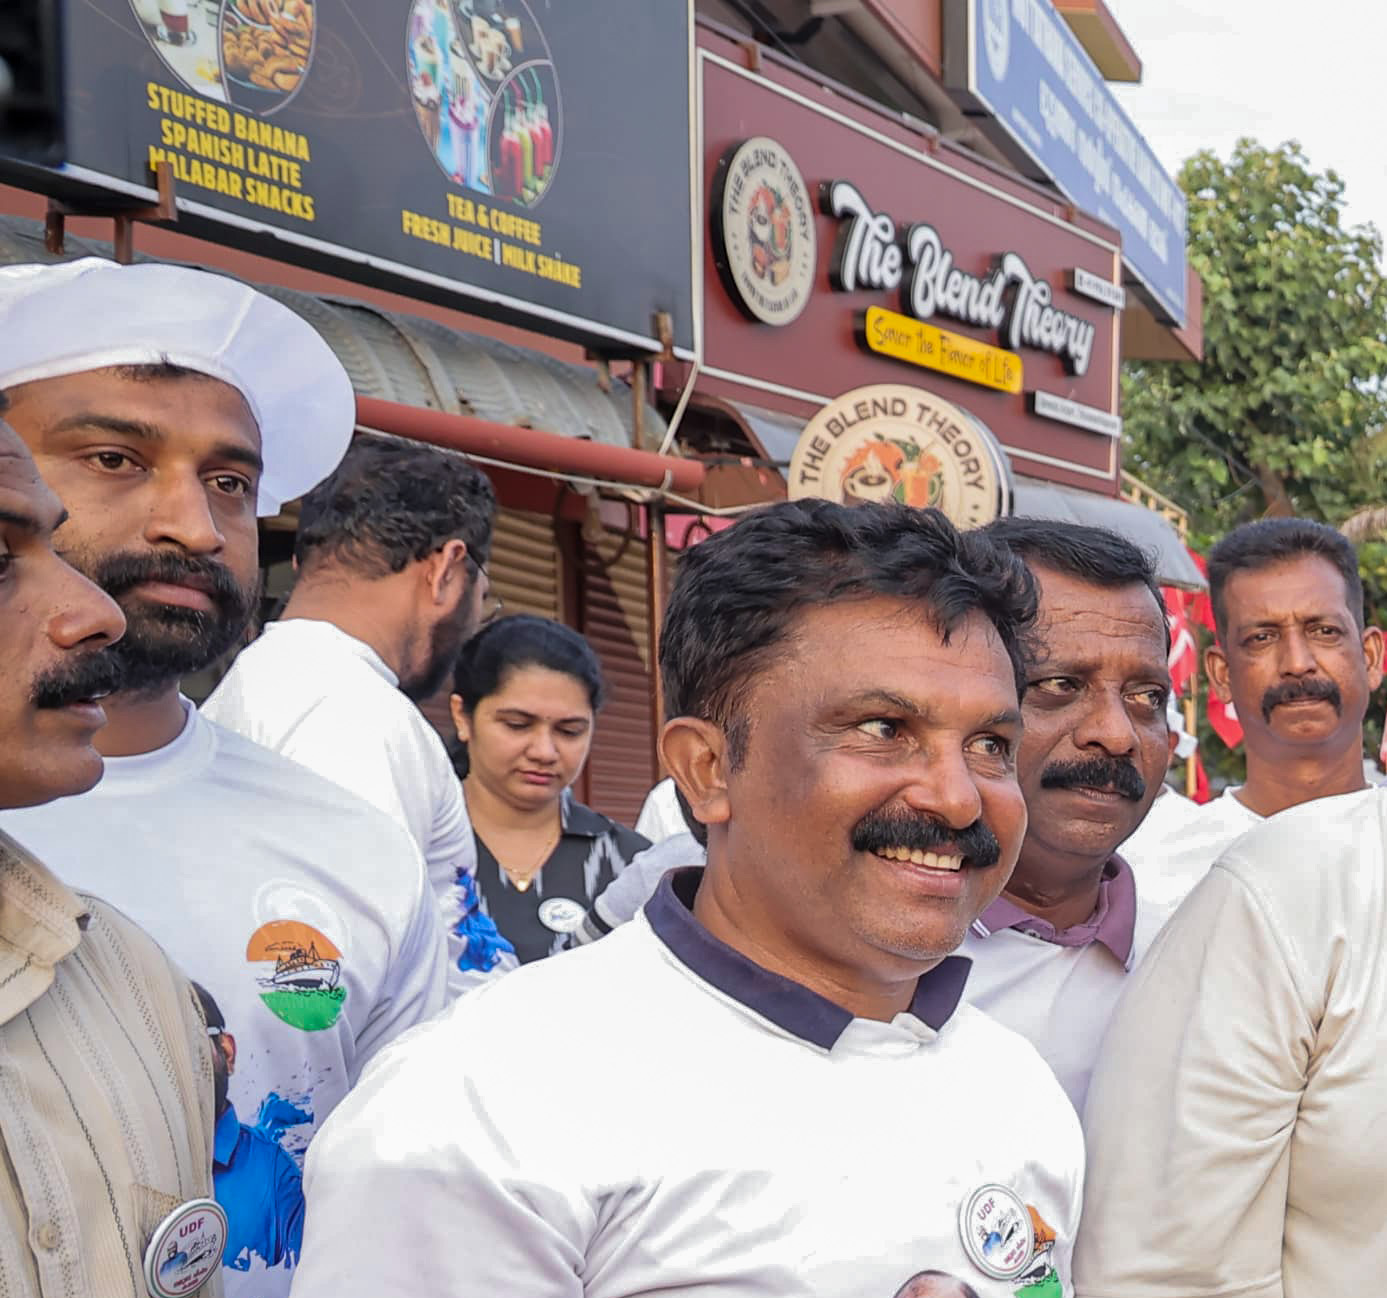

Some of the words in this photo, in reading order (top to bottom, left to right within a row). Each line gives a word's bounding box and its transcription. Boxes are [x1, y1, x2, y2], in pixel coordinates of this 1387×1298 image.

[146, 82, 231, 134] STUFFED
[233, 112, 311, 162] BANANA
[161, 118, 245, 170] SPANISH
[247, 147, 302, 188] LATTE
[149, 144, 243, 199] MALABAR
[245, 177, 316, 221] SNACKS
[727, 173, 744, 216] THE
[402, 209, 451, 248] FRESH
[452, 226, 493, 261] JUICE
[502, 242, 537, 275] MILK
[537, 254, 582, 289] SHAKE
[446, 192, 476, 224] TEA
[477, 203, 490, 230] &
[490, 208, 542, 246] COFFEE
[831, 180, 903, 291] The
[908, 223, 1005, 320] Blend
[1002, 252, 1096, 376] Theory
[917, 327, 933, 354] the
[799, 435, 832, 486] THE
[825, 397, 908, 439] BLEND
[915, 402, 986, 492] THEORY
[179, 1217, 205, 1238] UDF
[977, 1197, 996, 1221] UDF
